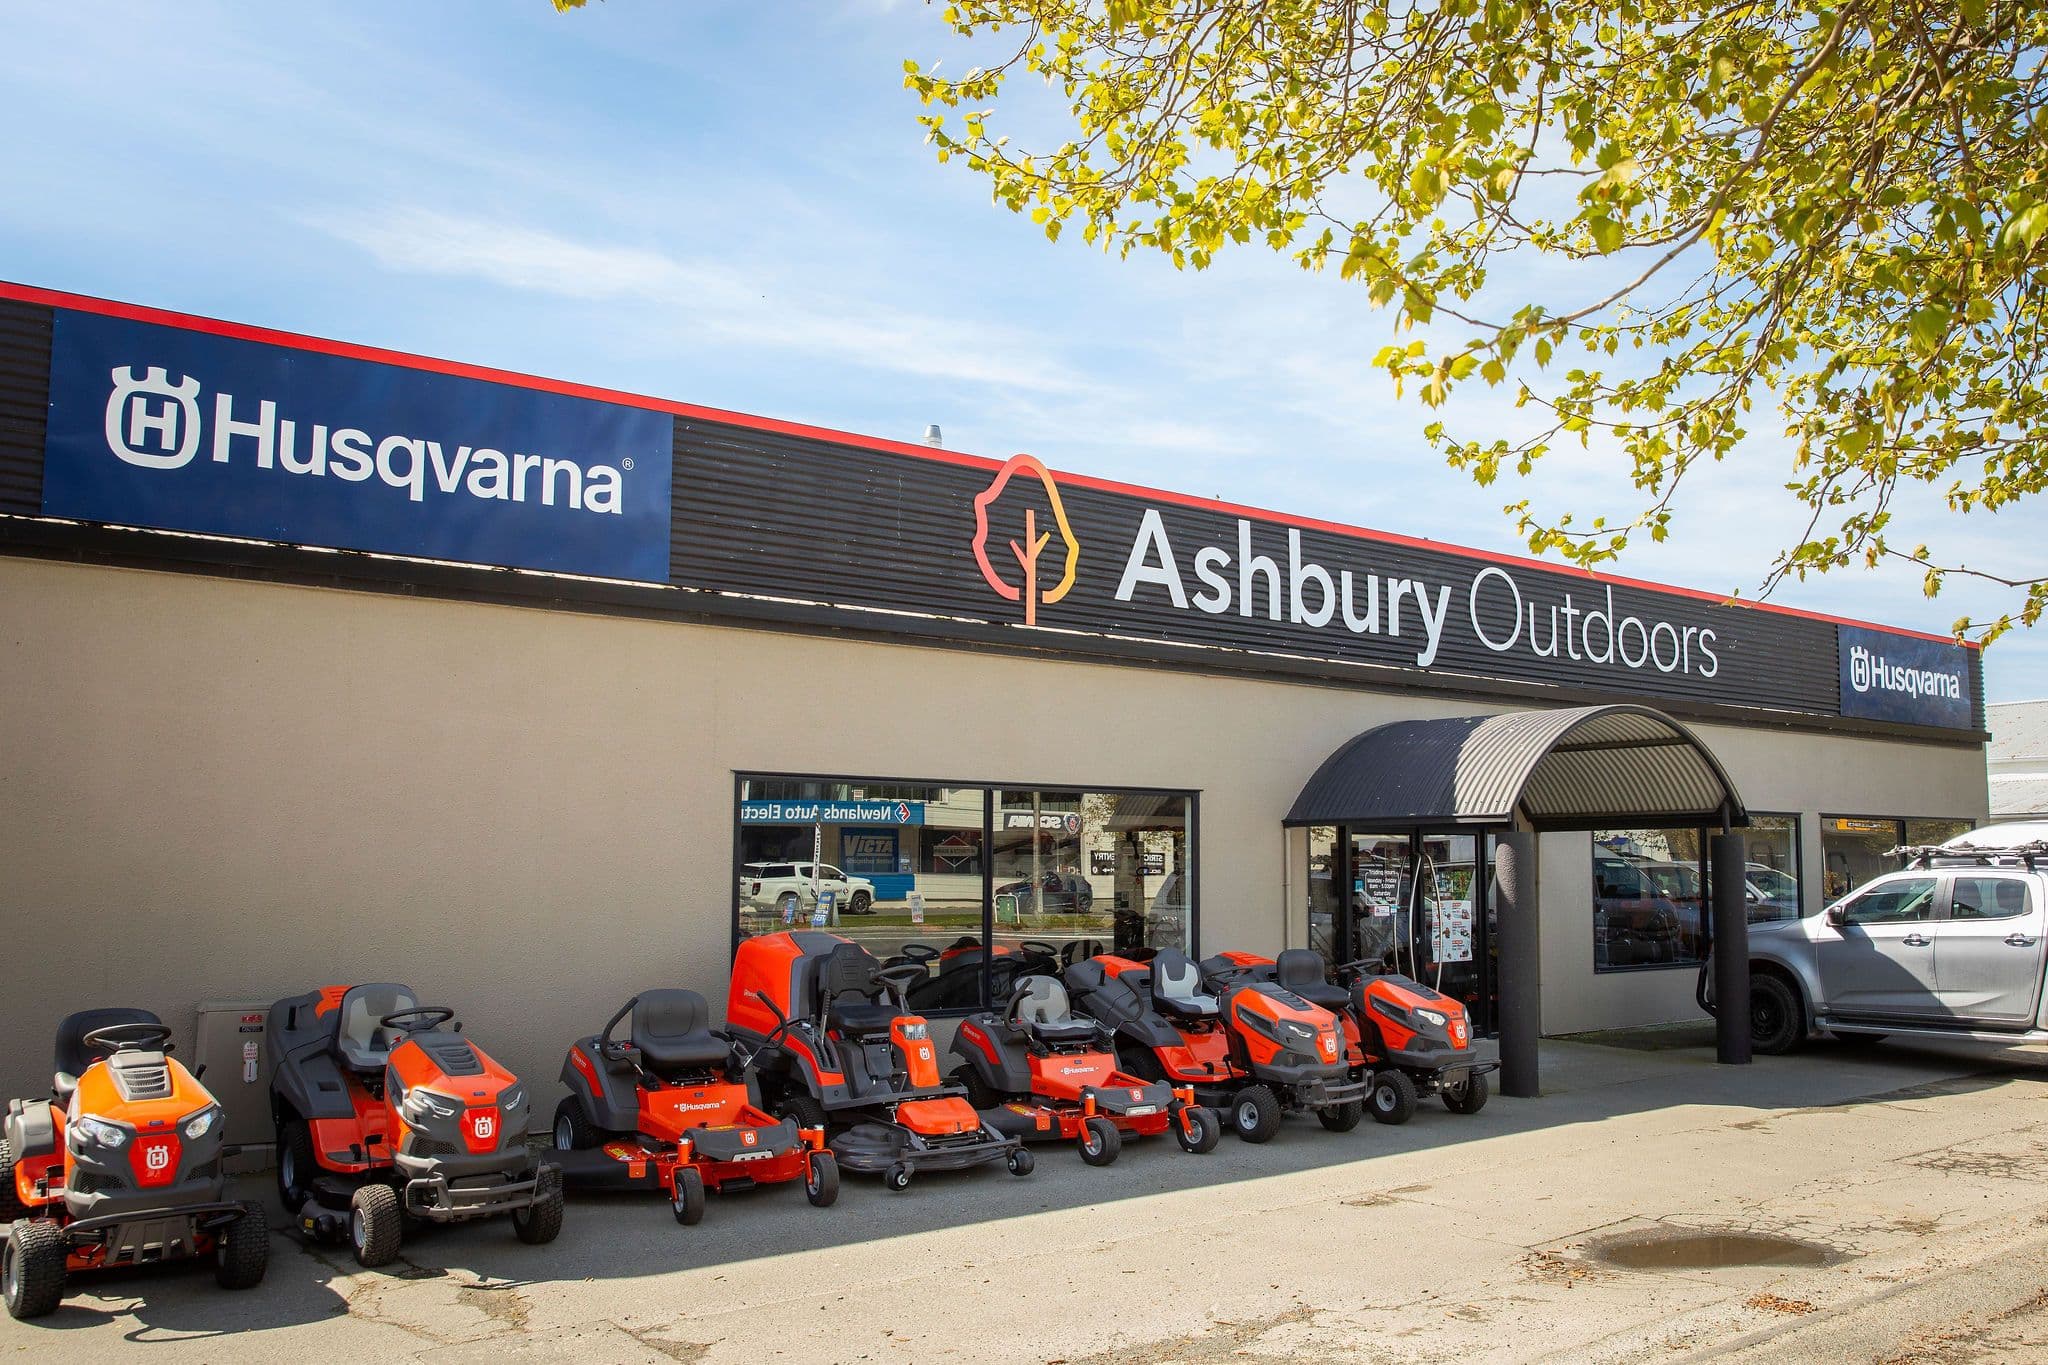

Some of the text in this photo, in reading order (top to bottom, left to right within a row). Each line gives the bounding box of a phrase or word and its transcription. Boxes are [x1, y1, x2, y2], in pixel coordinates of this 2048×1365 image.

[212, 393, 624, 515] Husqvarna
[1115, 508, 1719, 679] Ashbury Outdoors
[1871, 655, 1961, 699] Husqvarna
[686, 1102, 720, 1111] Husqvarna
